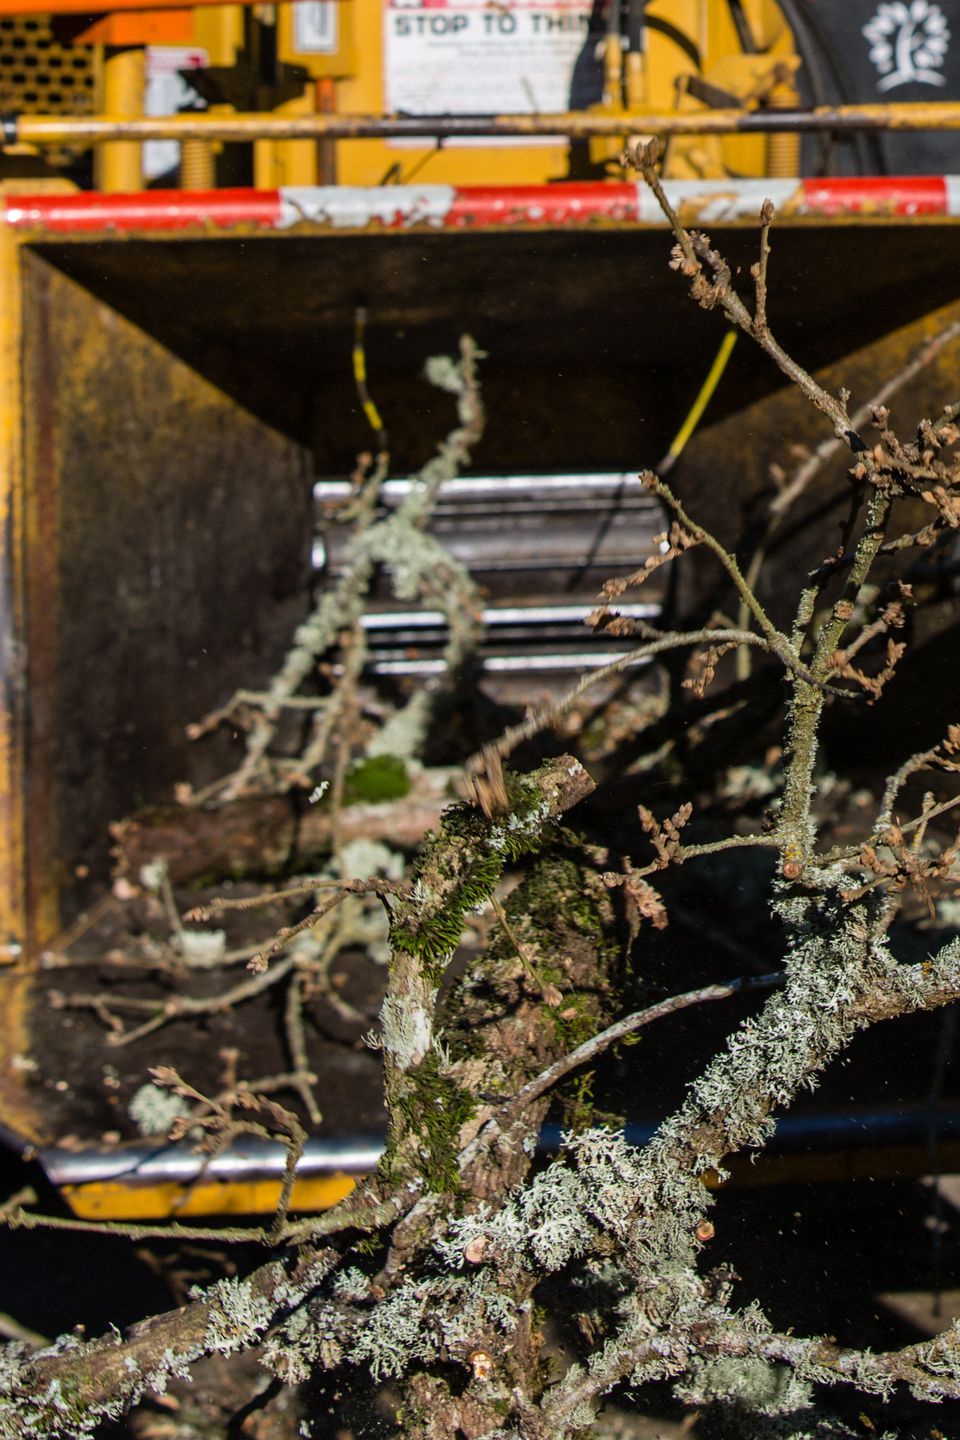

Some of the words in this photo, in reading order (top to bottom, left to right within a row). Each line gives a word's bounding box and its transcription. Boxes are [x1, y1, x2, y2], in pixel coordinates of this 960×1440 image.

[394, 14, 469, 35] STOP
[483, 14, 517, 34] TO
[531, 13, 591, 33] THIN
